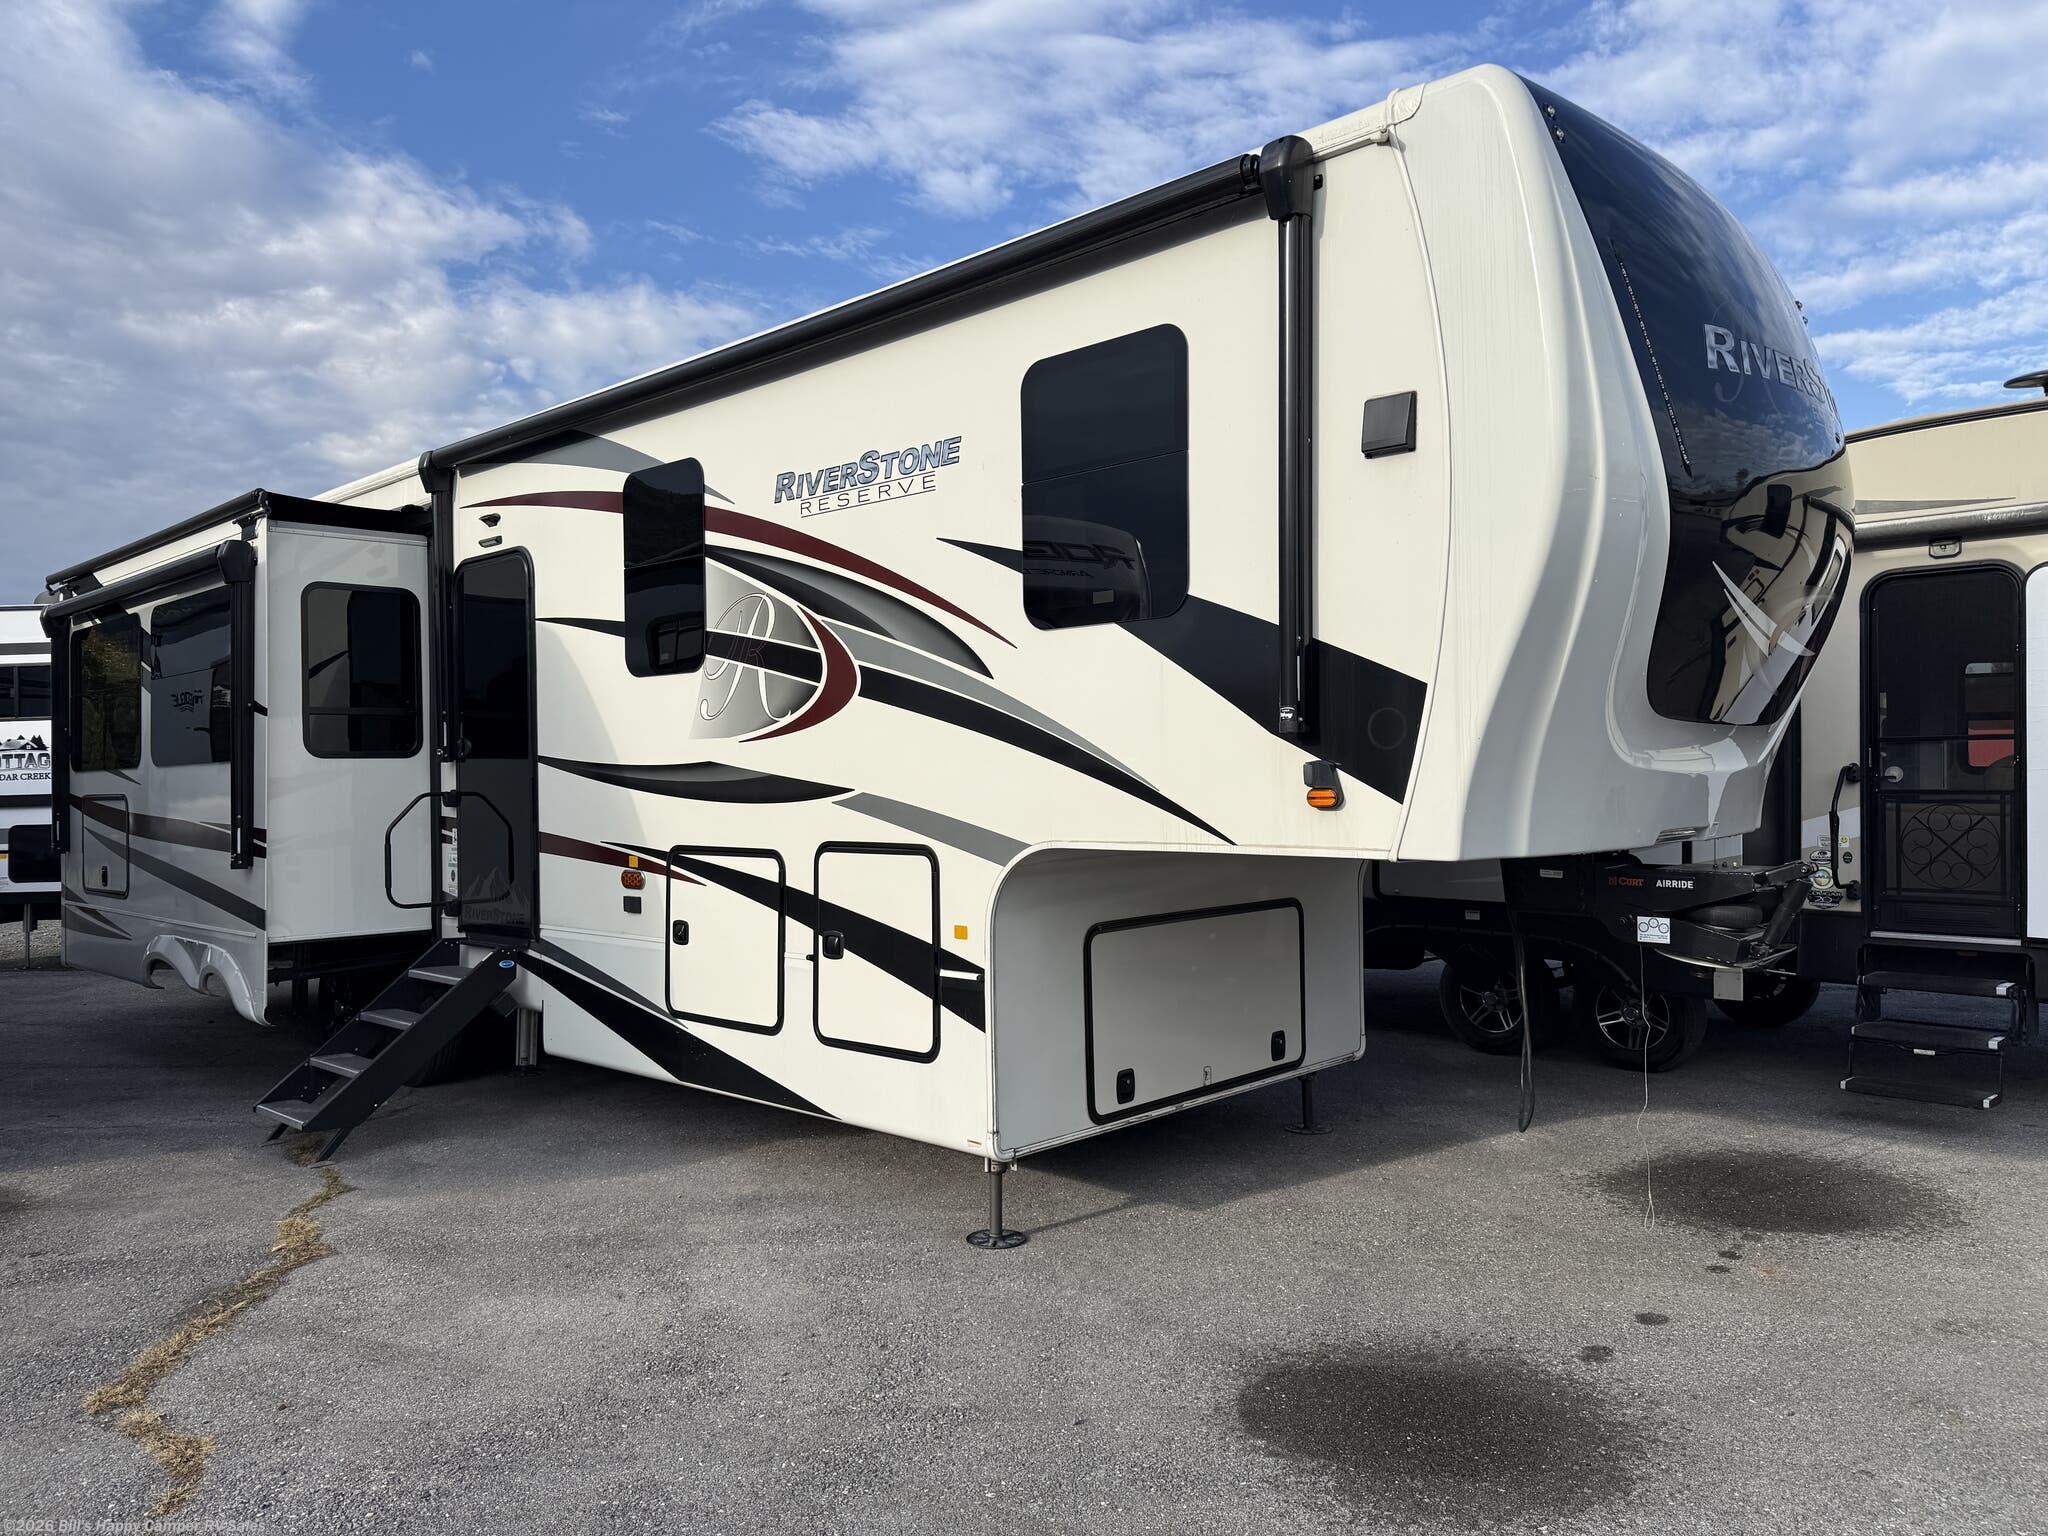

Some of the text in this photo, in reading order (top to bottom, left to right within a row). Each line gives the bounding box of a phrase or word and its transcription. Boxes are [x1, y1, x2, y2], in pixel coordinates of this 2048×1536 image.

[774, 435, 962, 503] RIVERSTONE
[800, 474, 937, 517] RESERVE
[0, 753, 51, 769] TTAG
[0, 772, 52, 781] DAR CREEK
[1656, 879, 1694, 889] AIRRIDE
